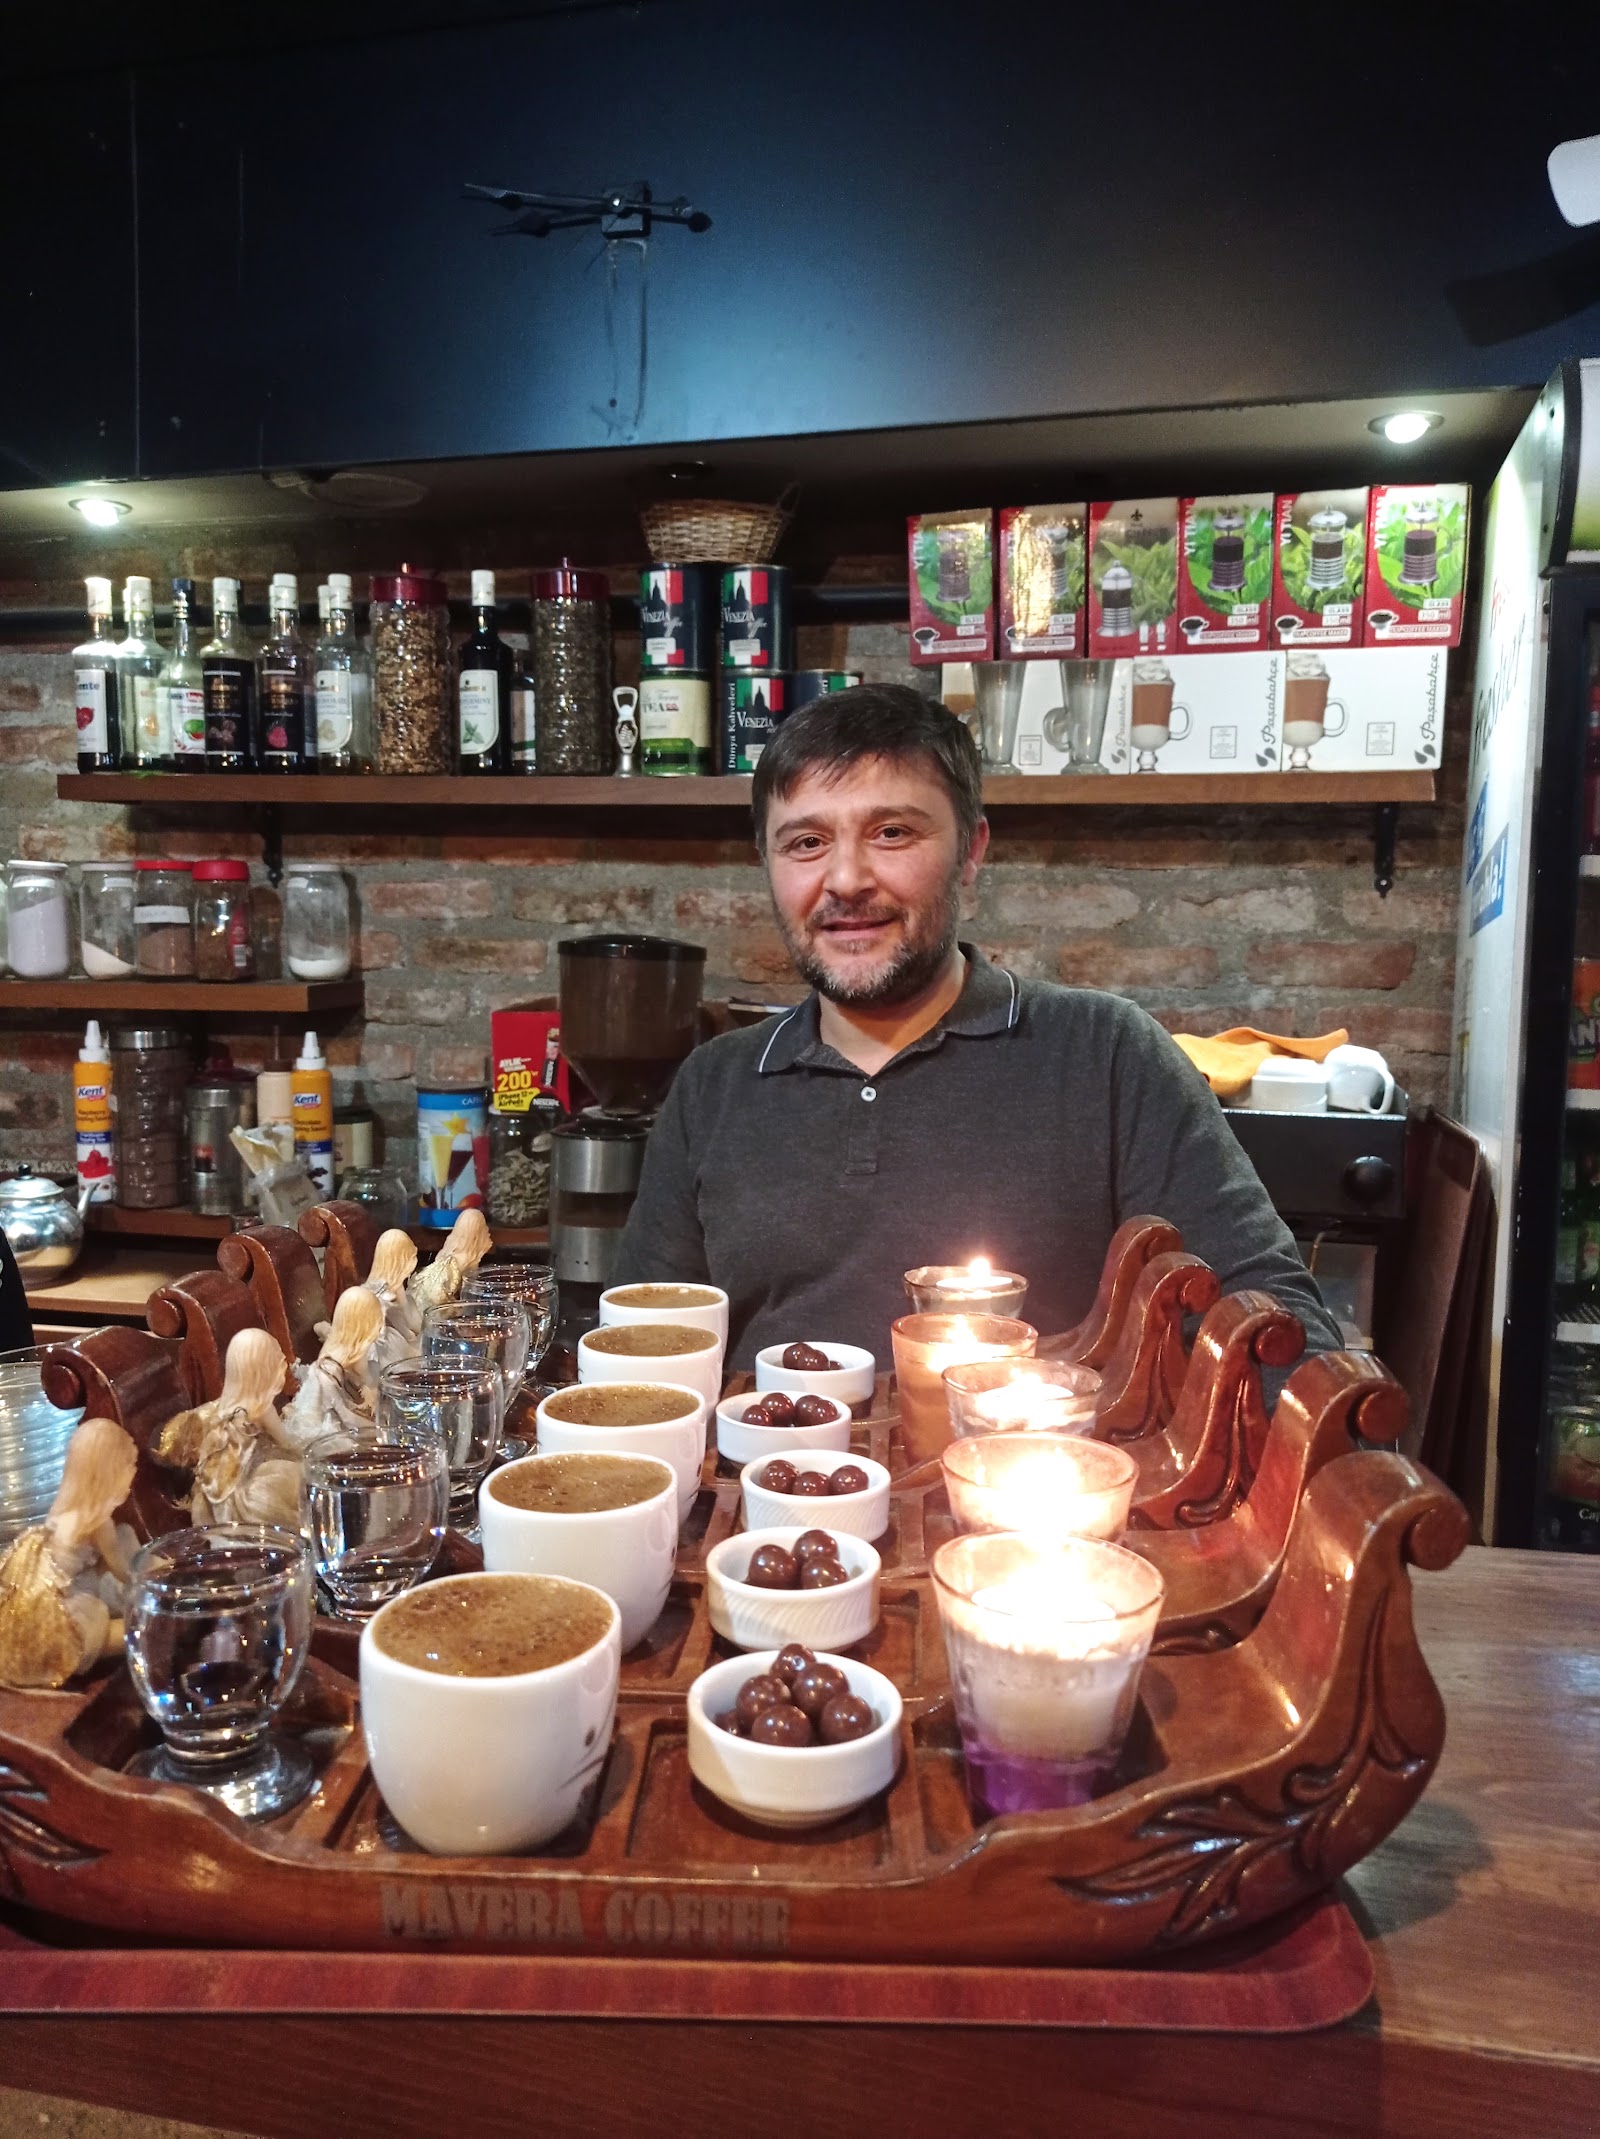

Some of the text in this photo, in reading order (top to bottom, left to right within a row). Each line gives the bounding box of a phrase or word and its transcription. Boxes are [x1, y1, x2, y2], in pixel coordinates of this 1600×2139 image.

[78, 1086, 104, 1096] Kent
[294, 1094, 319, 1104] Kent
[380, 1882, 792, 1954] MAVERA COFFEE
